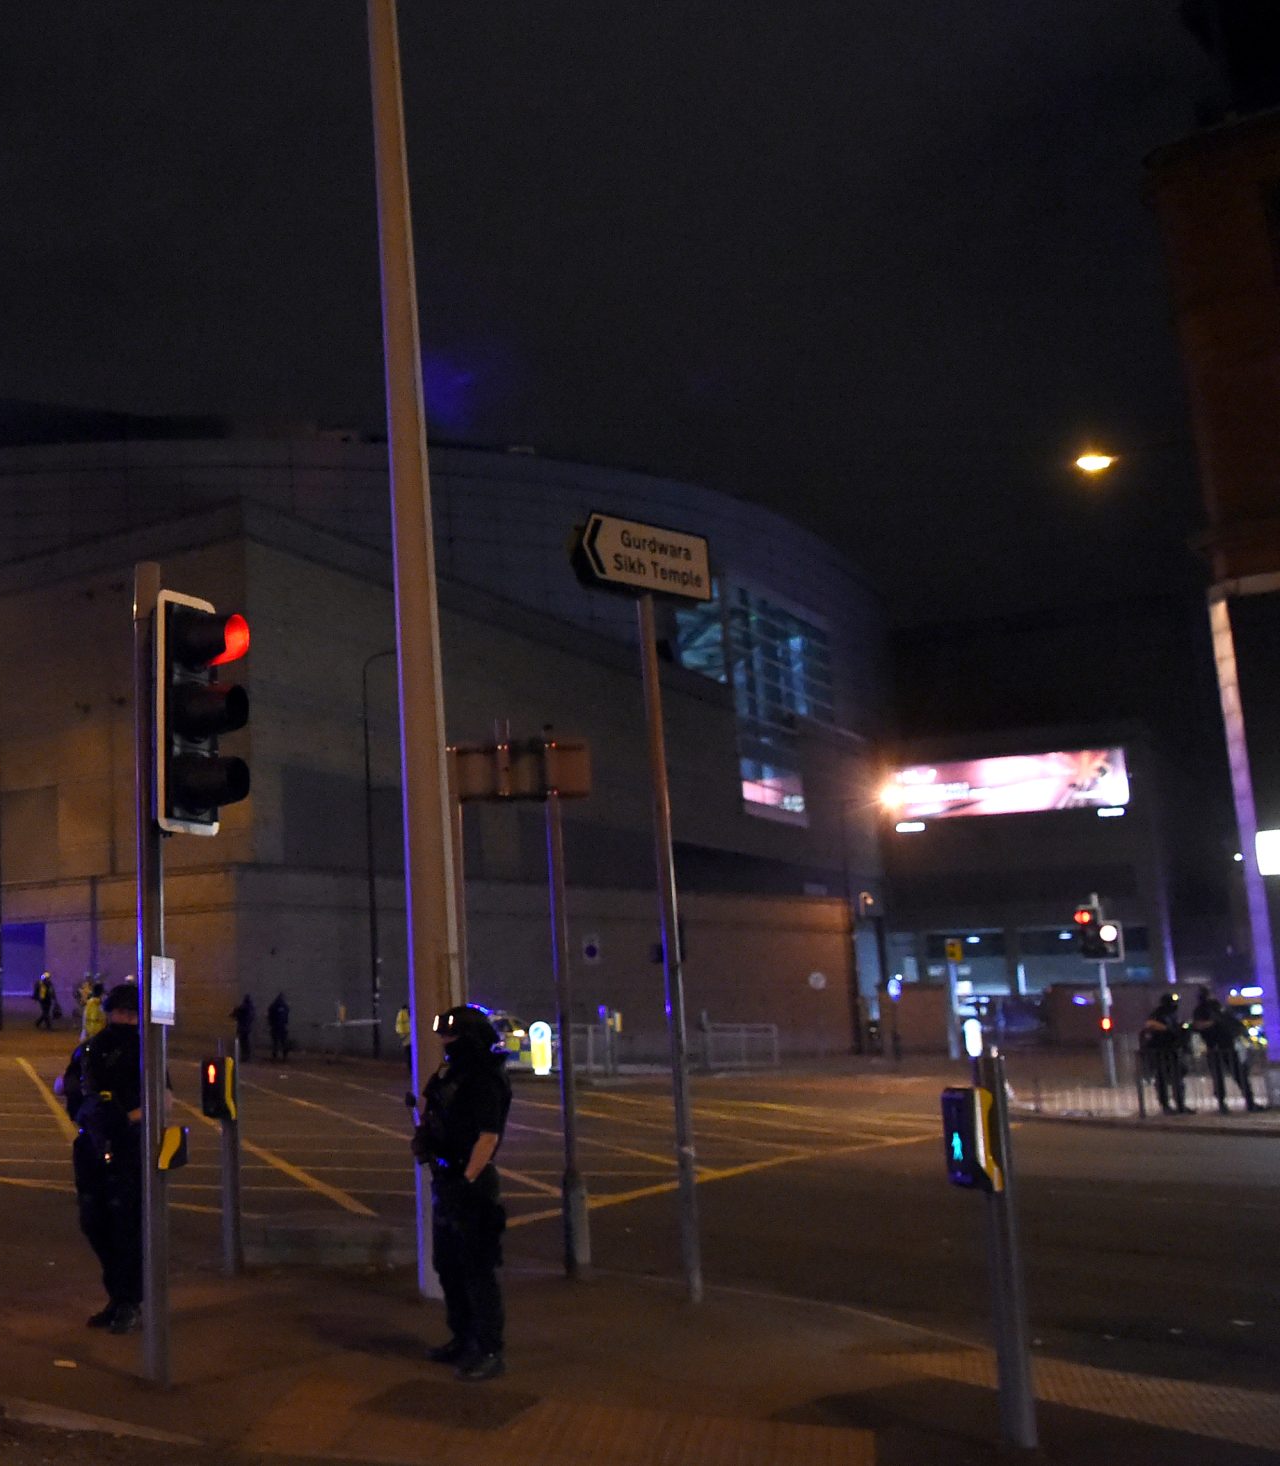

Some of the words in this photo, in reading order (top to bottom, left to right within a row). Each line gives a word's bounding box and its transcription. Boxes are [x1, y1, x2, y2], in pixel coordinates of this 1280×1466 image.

[621, 530, 692, 560] Gurdwara
[613, 554, 646, 575] Sikh
[651, 561, 702, 588] Temple
